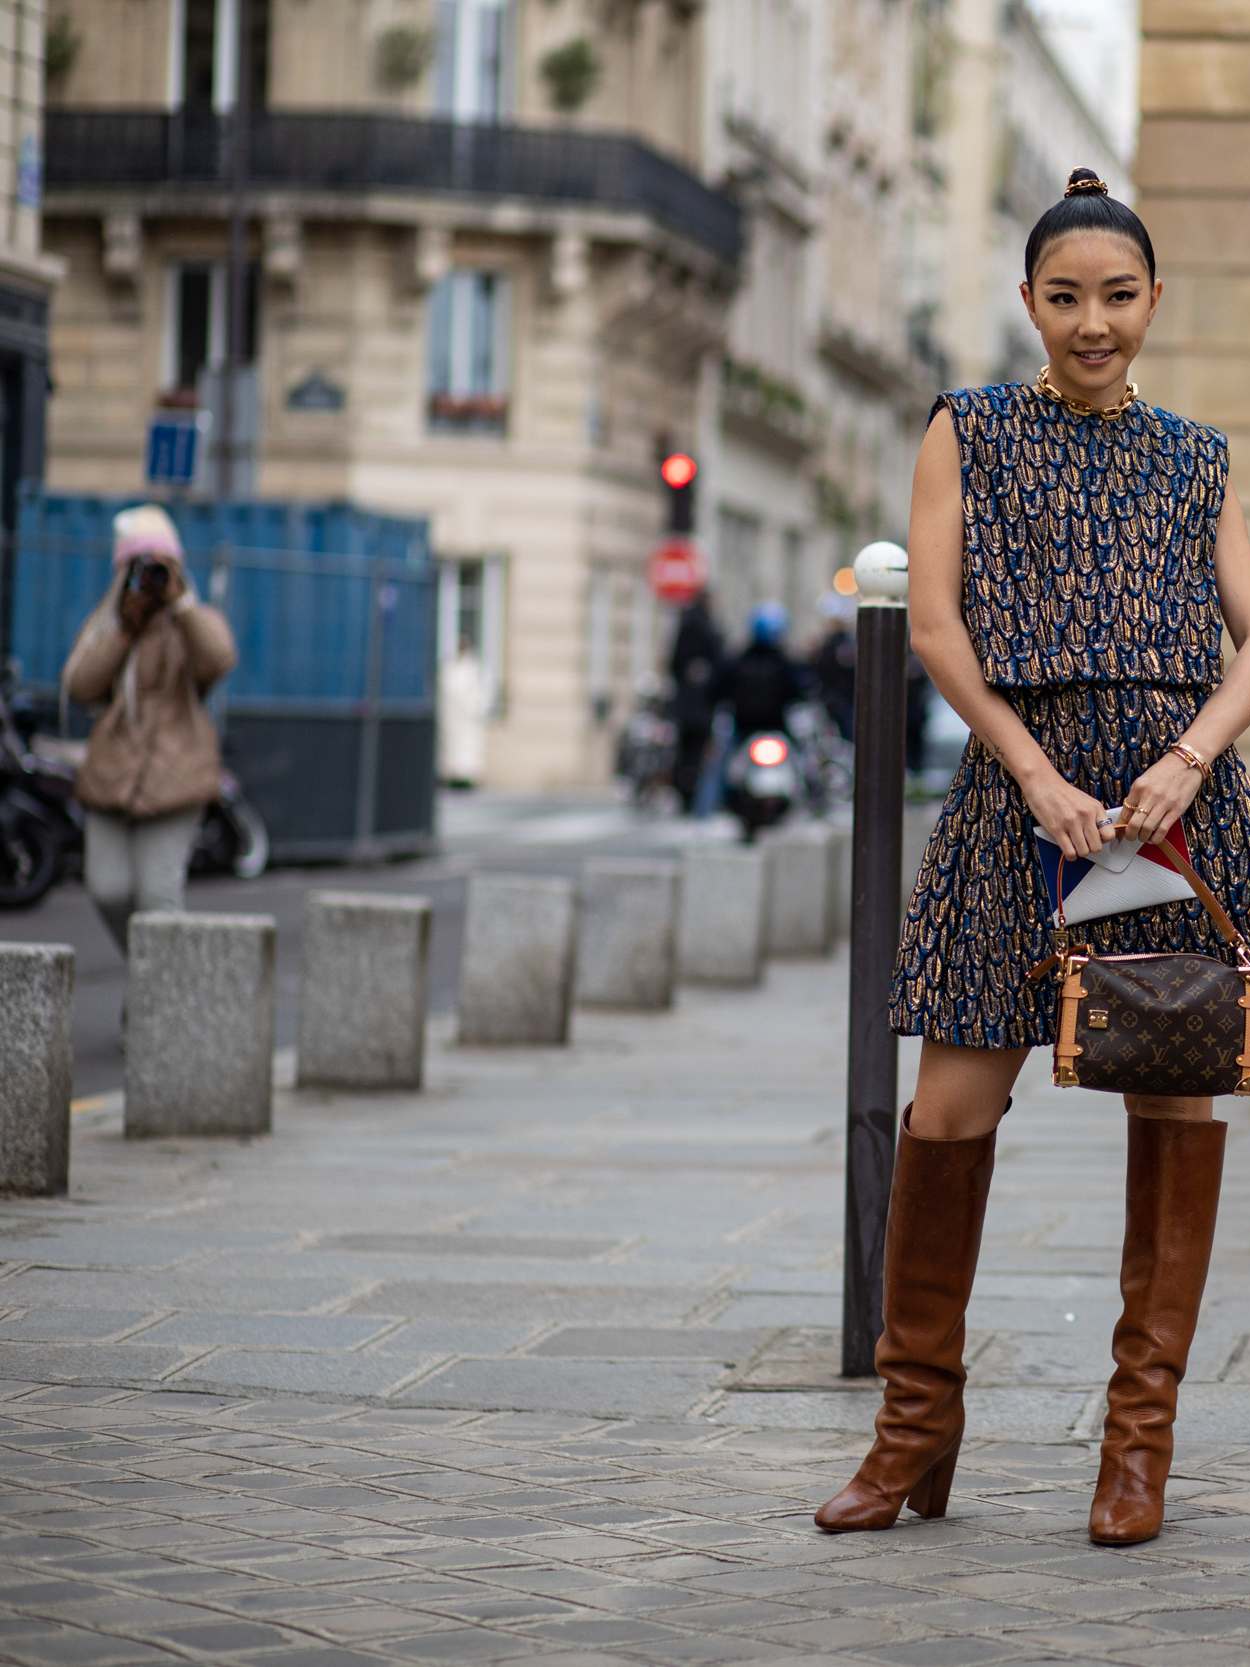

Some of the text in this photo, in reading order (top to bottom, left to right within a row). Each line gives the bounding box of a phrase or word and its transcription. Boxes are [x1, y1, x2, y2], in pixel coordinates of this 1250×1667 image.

[1090, 974, 1110, 995] LV
[1217, 982, 1236, 1003] LV
[1154, 988, 1172, 1004] LV
[1084, 1038, 1105, 1061] LV
[1149, 1044, 1171, 1066] LV
[1214, 1047, 1235, 1068] LV
